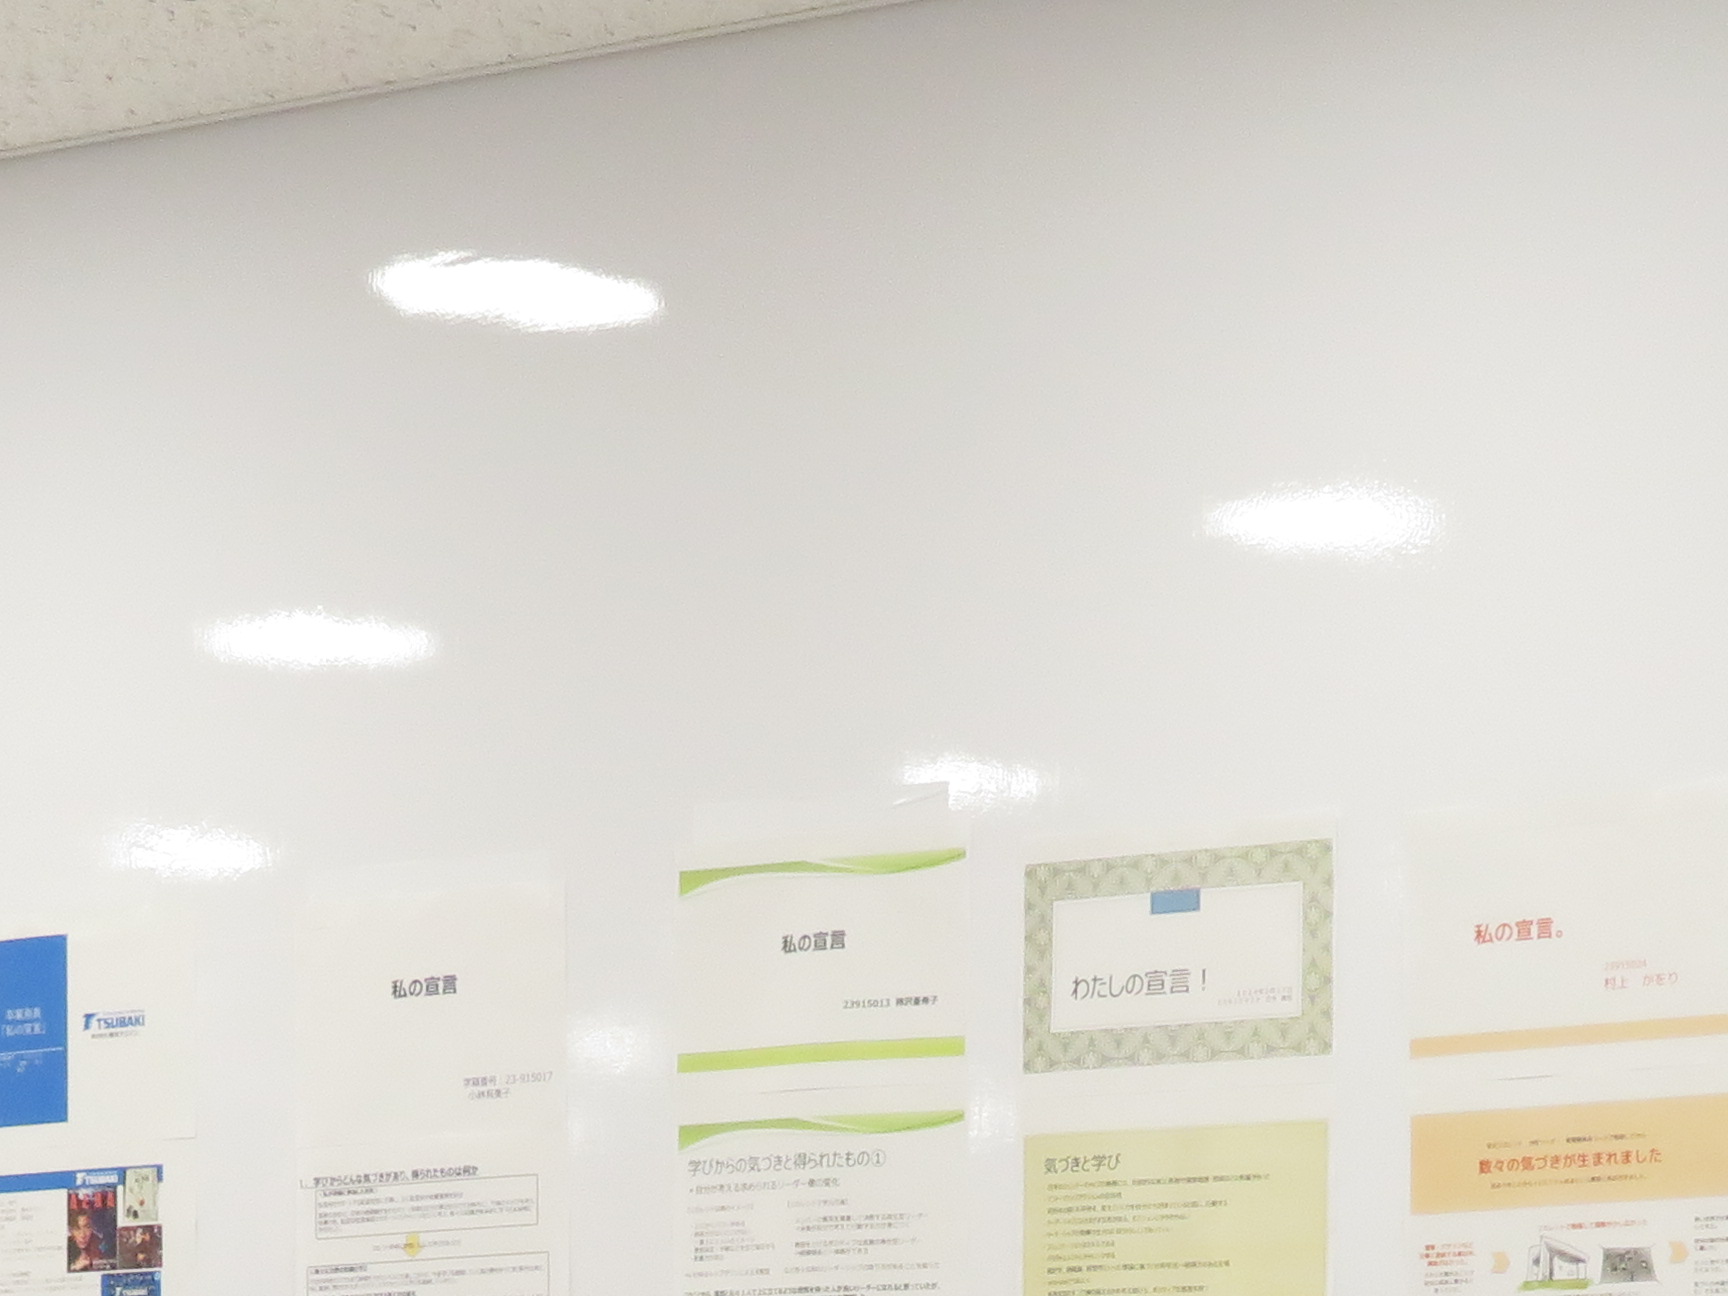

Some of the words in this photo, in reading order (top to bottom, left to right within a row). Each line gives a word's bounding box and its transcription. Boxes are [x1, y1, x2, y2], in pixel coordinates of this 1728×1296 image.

[781, 931, 846, 954] 私の宣言
[1473, 917, 1564, 945] 私の宣言。
[390, 974, 458, 999] 私の宣言
[1071, 968, 1208, 1001] わたしの宣言！
[97, 1013, 145, 1030] TSUBAKI
[688, 1150, 886, 1177] 学びからの気づきと得られたもの①
[1043, 1153, 1121, 1175] 気づきと学び
[1479, 1148, 1663, 1174] 数々の気づきが生まれました
